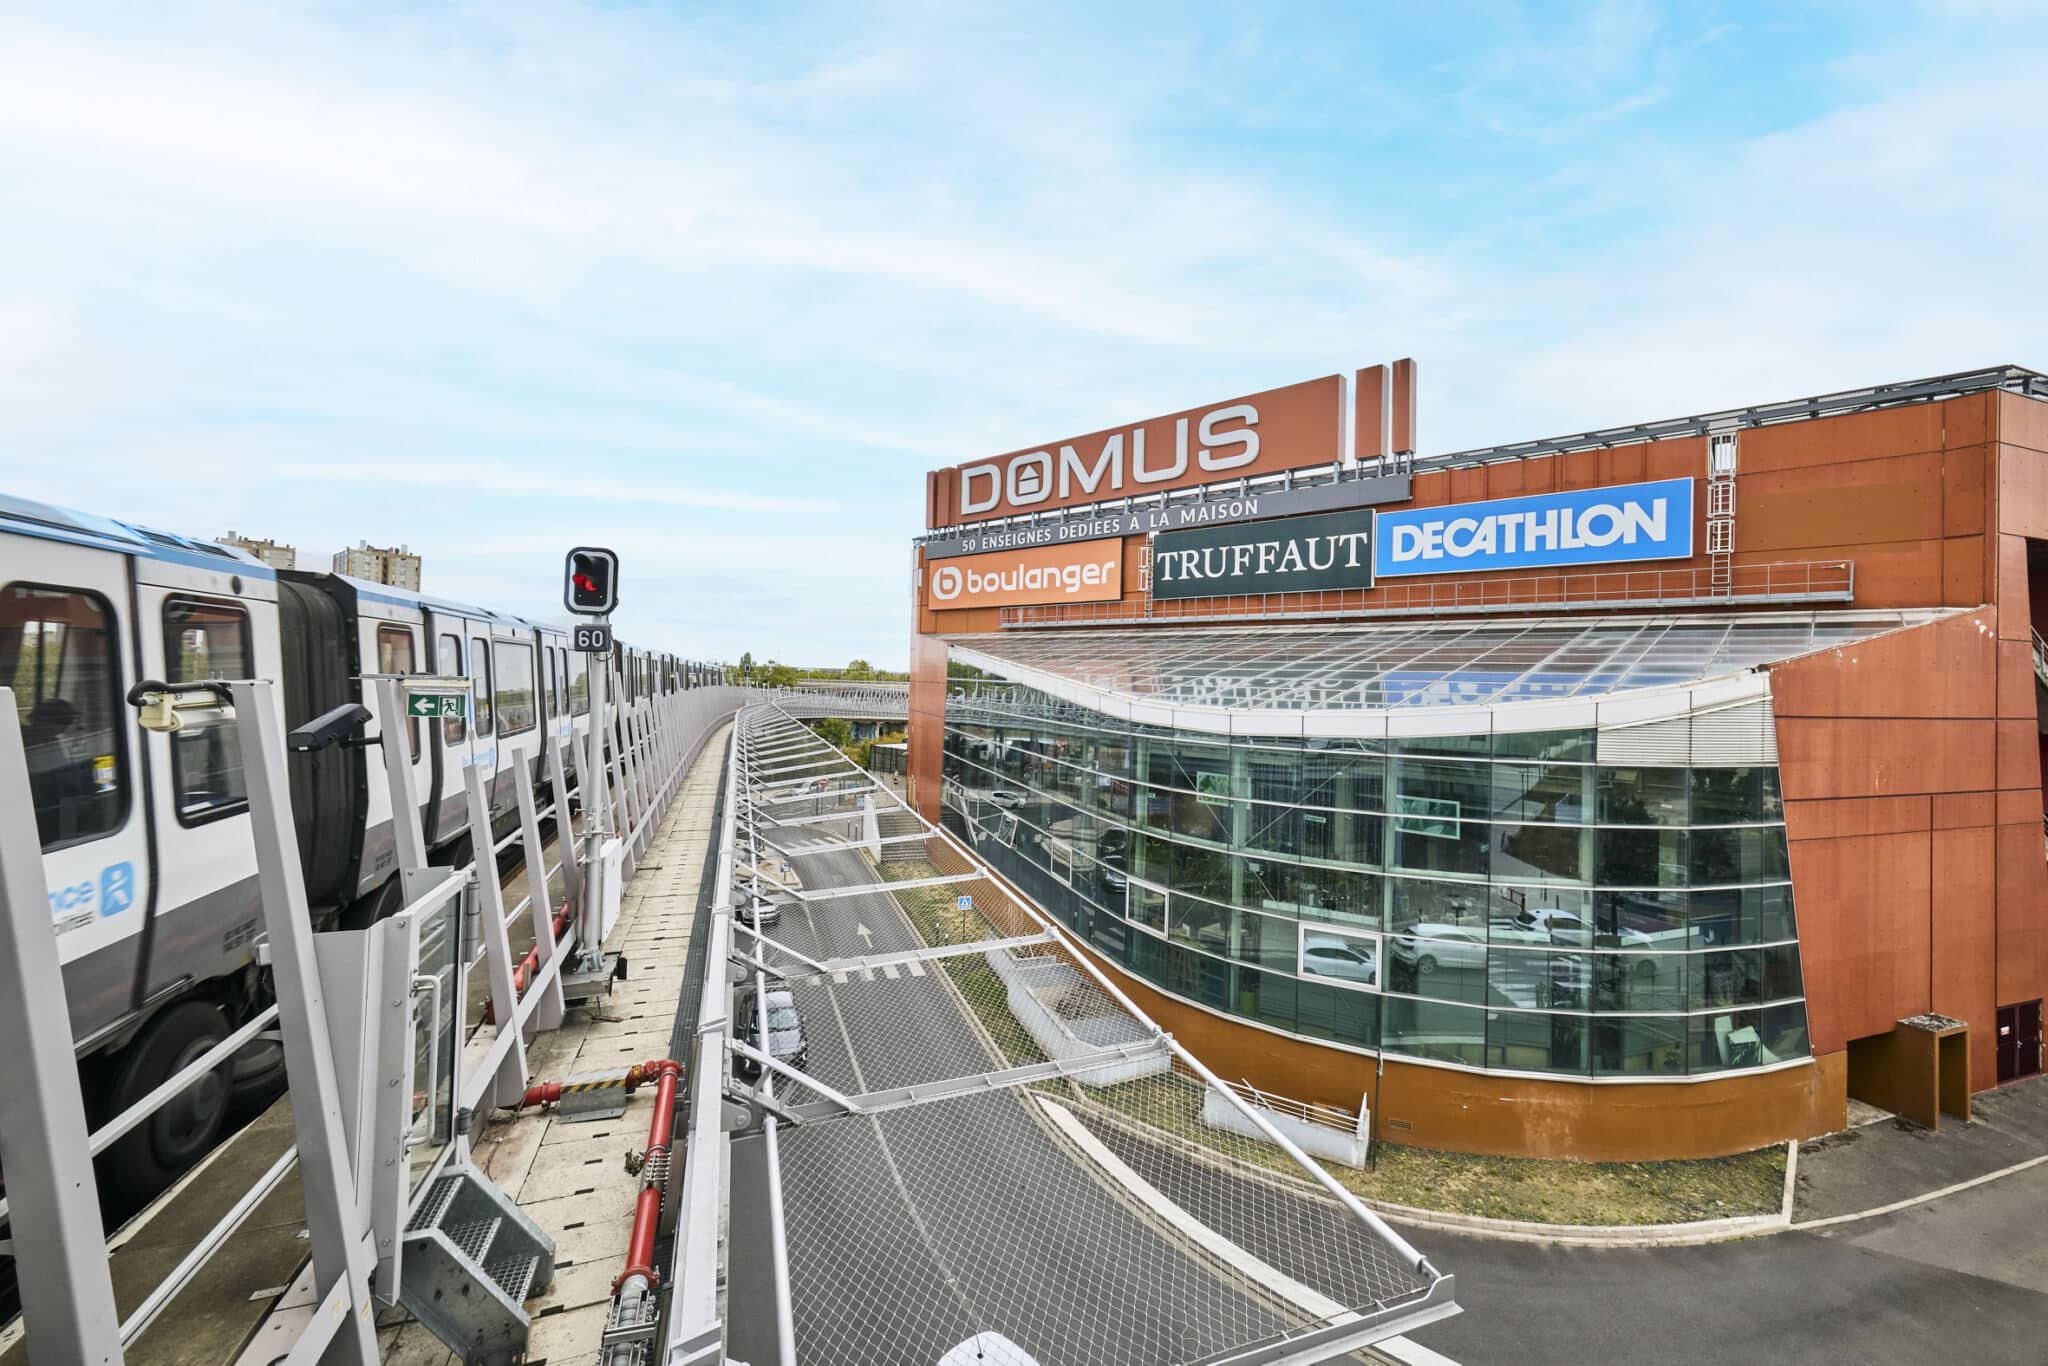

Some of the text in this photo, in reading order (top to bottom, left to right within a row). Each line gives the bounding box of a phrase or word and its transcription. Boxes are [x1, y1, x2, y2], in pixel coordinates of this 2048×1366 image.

[961, 404, 1260, 515] DOMUS
[962, 538, 976, 552] 50
[982, 528, 1051, 549] ENSEIGNES
[1060, 518, 1120, 539] DEDIEES
[1150, 512, 1170, 528] LA
[1180, 499, 1258, 524] MAISON
[1392, 498, 1667, 562] DECATHLON
[967, 561, 1115, 593] boulanger
[1156, 532, 1368, 581] TRUFFAUT
[578, 630, 604, 647] 60
